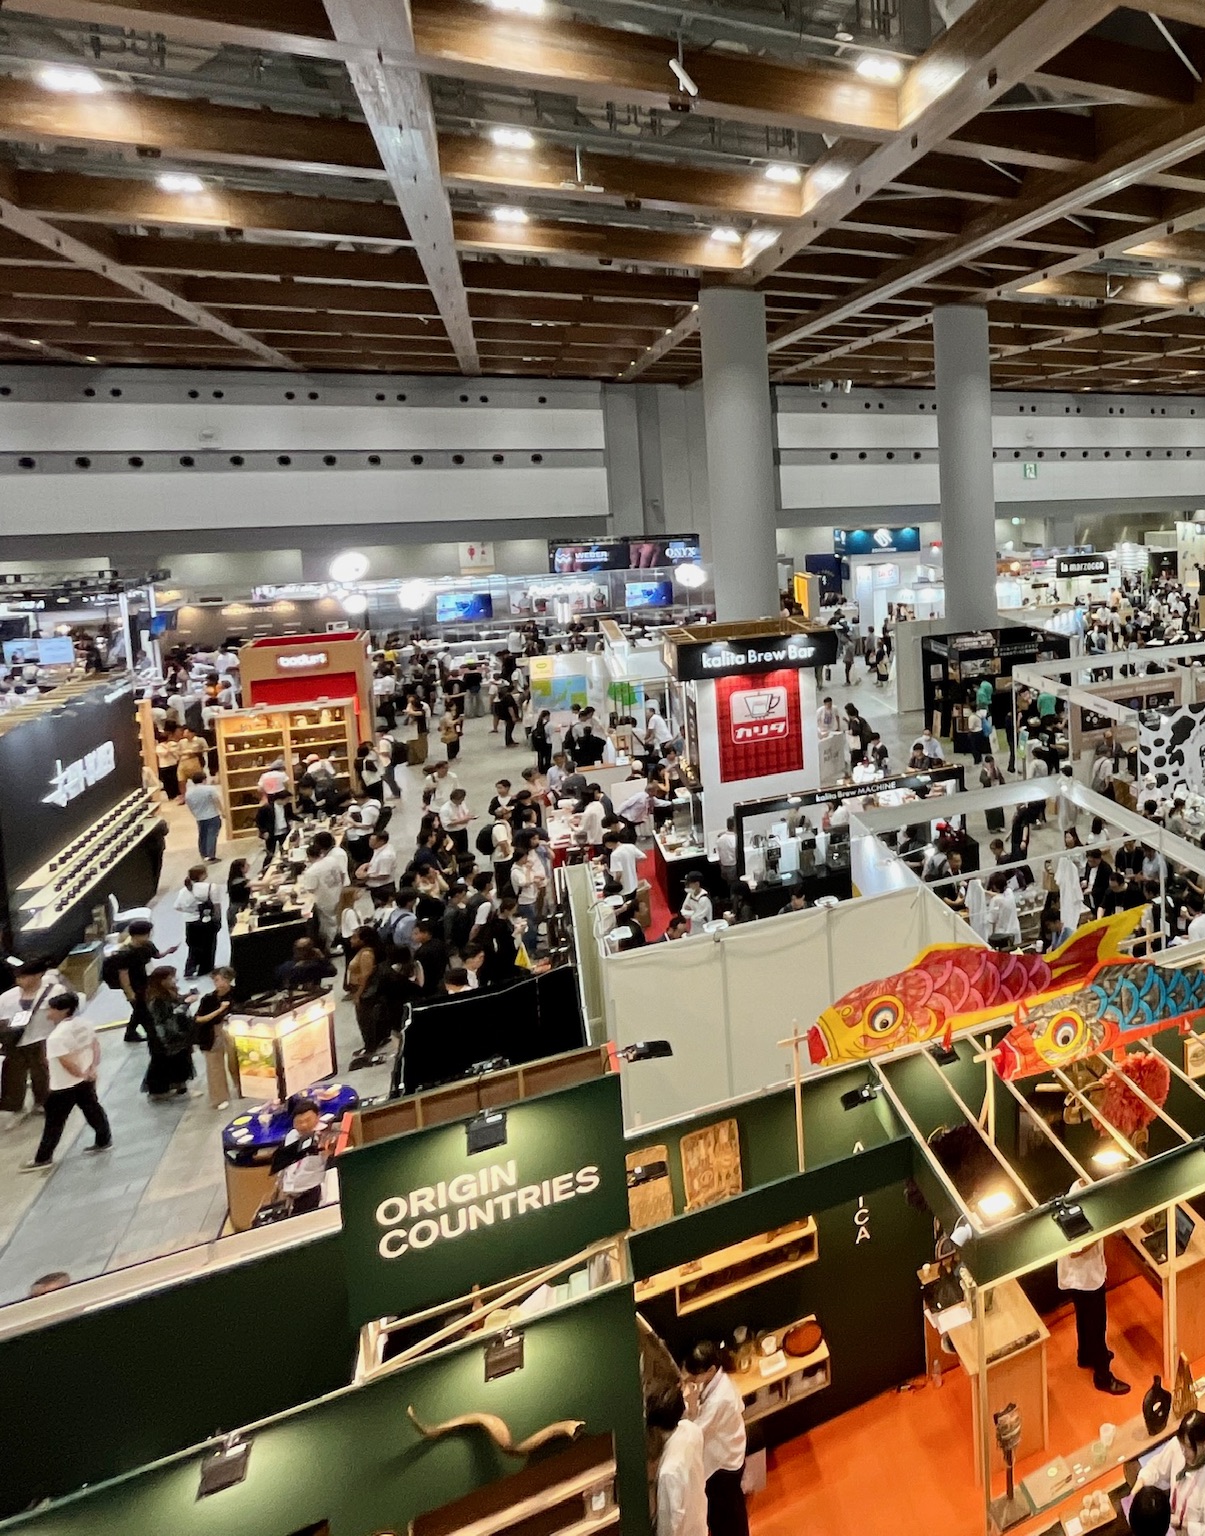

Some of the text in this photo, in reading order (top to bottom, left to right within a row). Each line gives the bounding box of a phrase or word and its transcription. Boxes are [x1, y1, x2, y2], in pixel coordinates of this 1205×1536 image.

[665, 547, 697, 558] ONYX
[1069, 560, 1105, 572] marzocco
[701, 643, 815, 669] kalita Brew Bar
[735, 720, 786, 740] カリタ
[857, 780, 897, 795] MACHINE
[376, 1160, 517, 1226] ORIGIN
[378, 1166, 600, 1259] COUNTRIES
